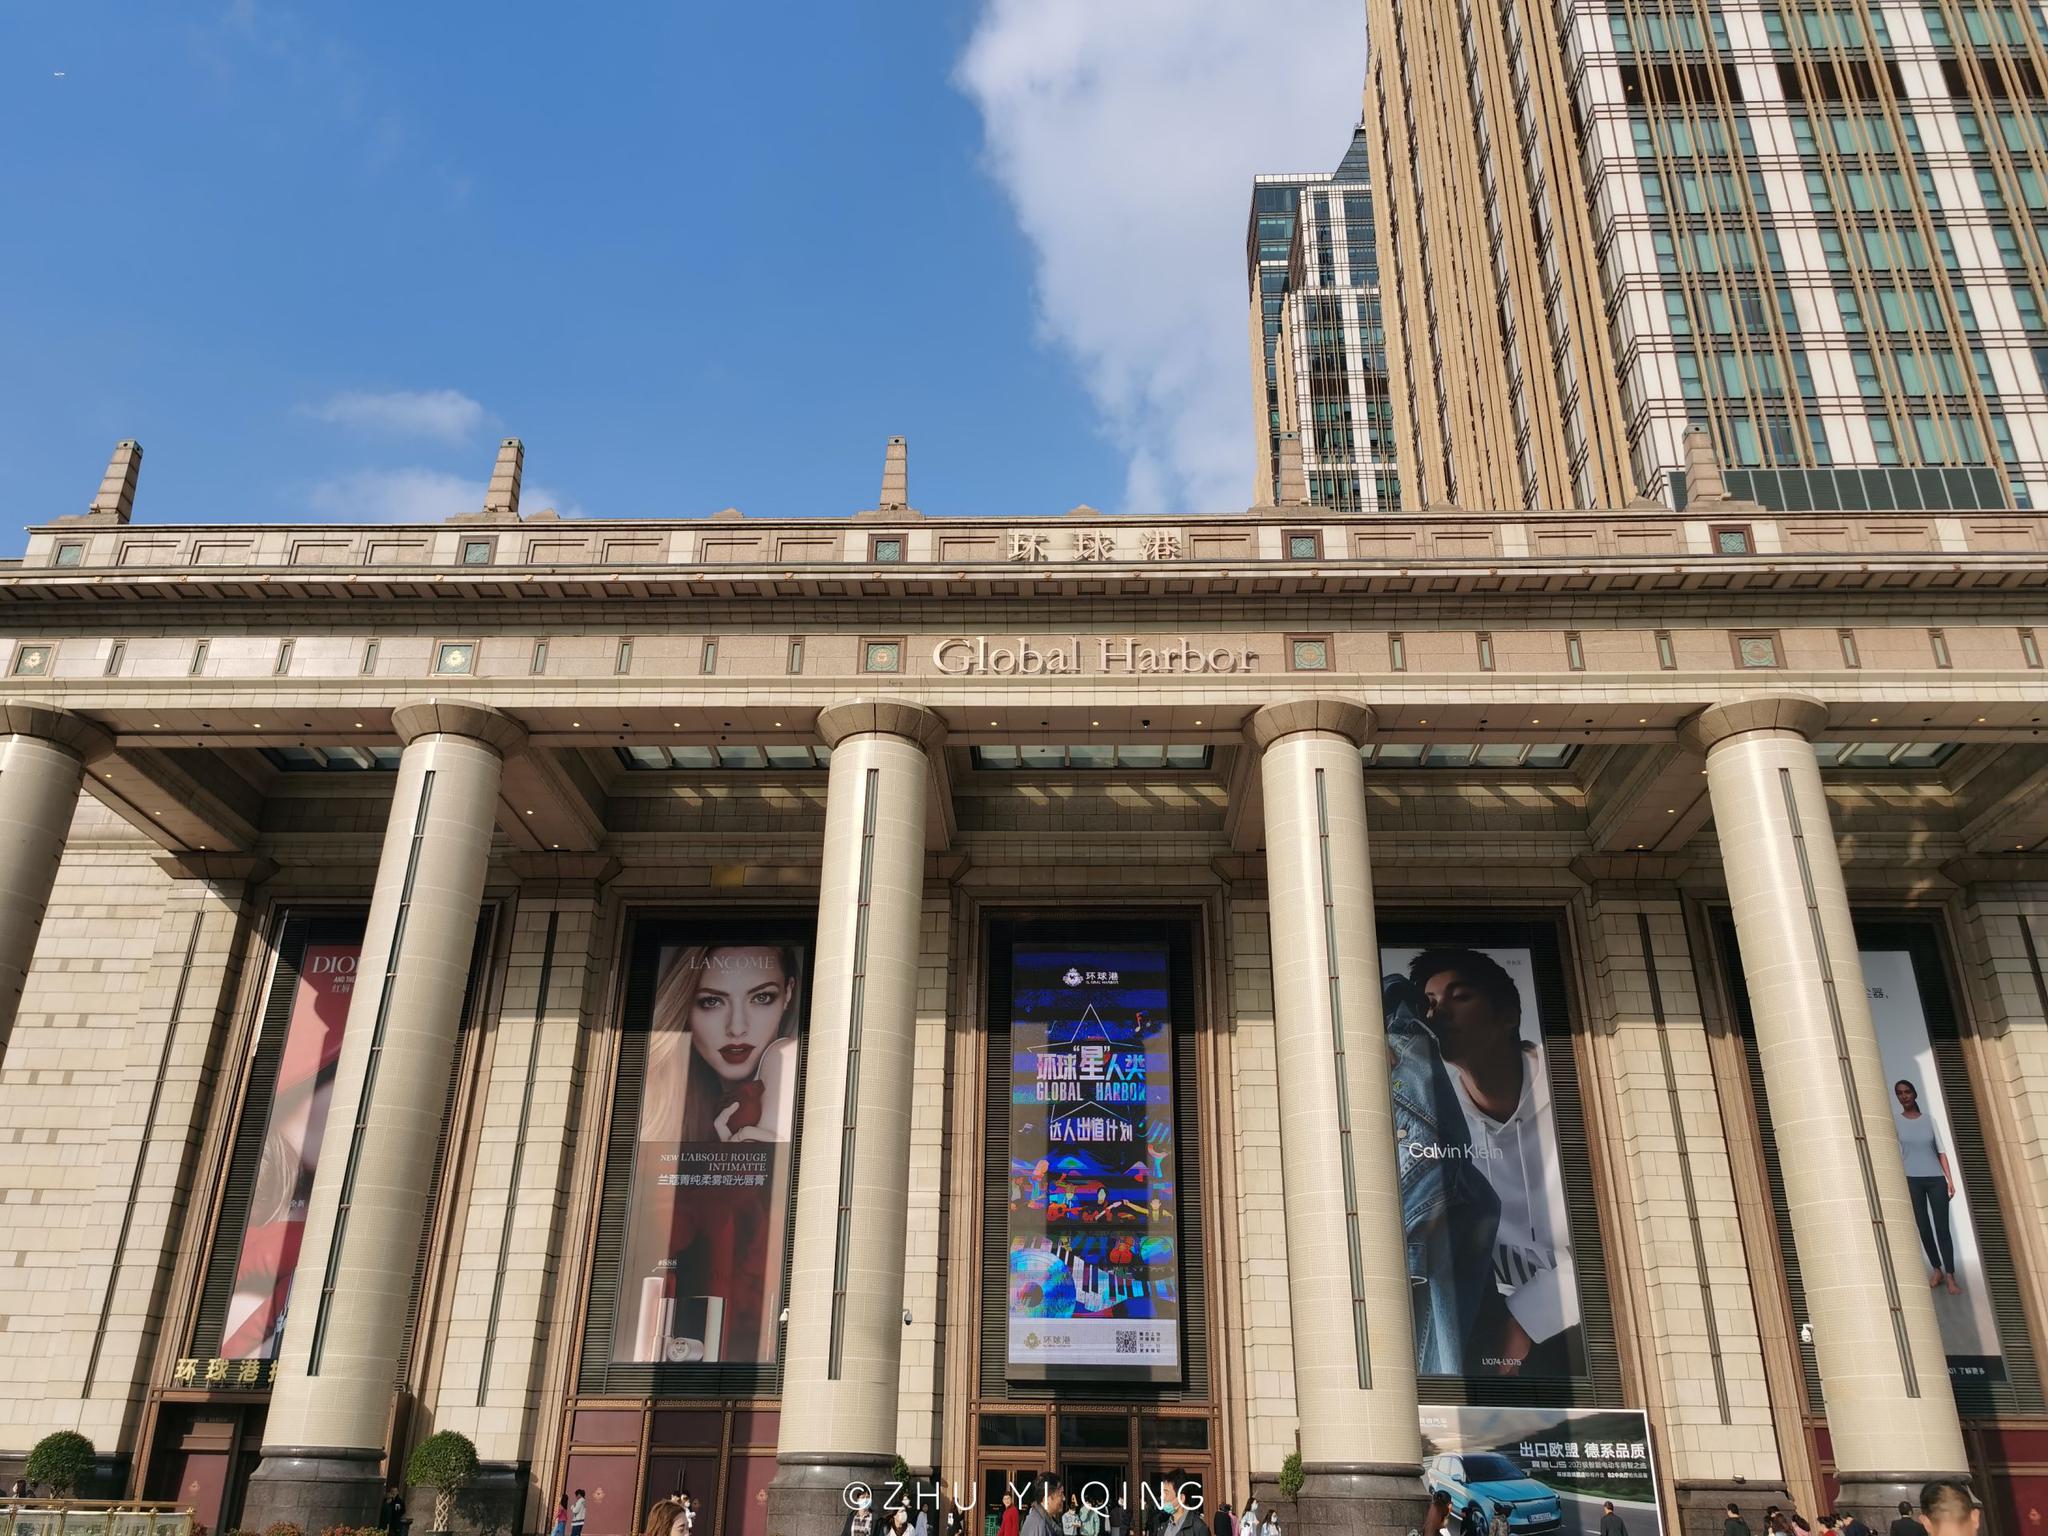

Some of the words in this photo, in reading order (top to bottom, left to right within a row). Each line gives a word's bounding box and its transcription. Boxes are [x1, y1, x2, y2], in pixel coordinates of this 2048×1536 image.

[1007, 528, 1181, 562] 环球港
[932, 636, 1081, 674] Global
[1095, 637, 1258, 674] Harbor
[312, 955, 361, 974] DIO
[1085, 971, 1119, 981] 环球港
[1036, 1081, 1084, 1102] GLOBAL
[1095, 1082, 1147, 1102] HARBOR
[1049, 1116, 1133, 1142] 达人出道计划
[730, 1152, 767, 1162] ROUGE
[1409, 1142, 1461, 1159] Calvin
[1463, 1143, 1504, 1160] Klein
[708, 1162, 767, 1172] INTIMATTE
[1519, 1441, 1580, 1458] 出口欧盟
[1584, 1442, 1646, 1459] 德系品质
